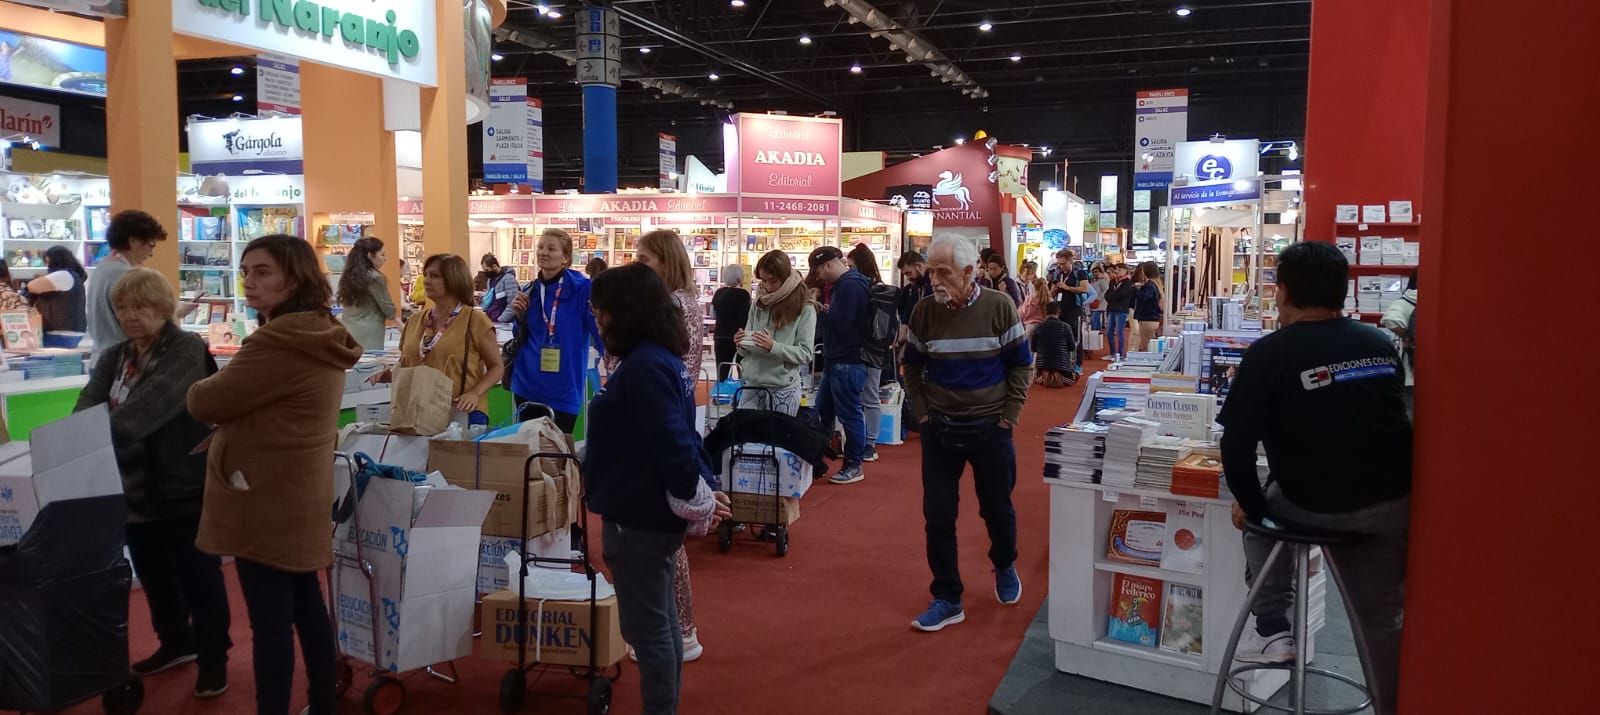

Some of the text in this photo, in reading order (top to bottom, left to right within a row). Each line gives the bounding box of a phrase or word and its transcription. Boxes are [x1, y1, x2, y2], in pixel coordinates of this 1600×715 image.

[260, 0, 420, 65] Naranjo
[0, 108, 42, 135] larín
[235, 132, 283, 155] Gárgola
[754, 150, 826, 166] AKADIA
[768, 171, 812, 188] Editorial
[601, 200, 658, 212] AKADIA
[763, 202, 830, 212] 11-2468-2081
[933, 211, 982, 220] NANTIAL
[1328, 358, 1372, 373] EDICIONES
[1147, 398, 1172, 410] CUENTOS
[1122, 579, 1130, 588] El
[1121, 586, 1156, 600] Federico
[495, 607, 577, 626] EDIORIAL
